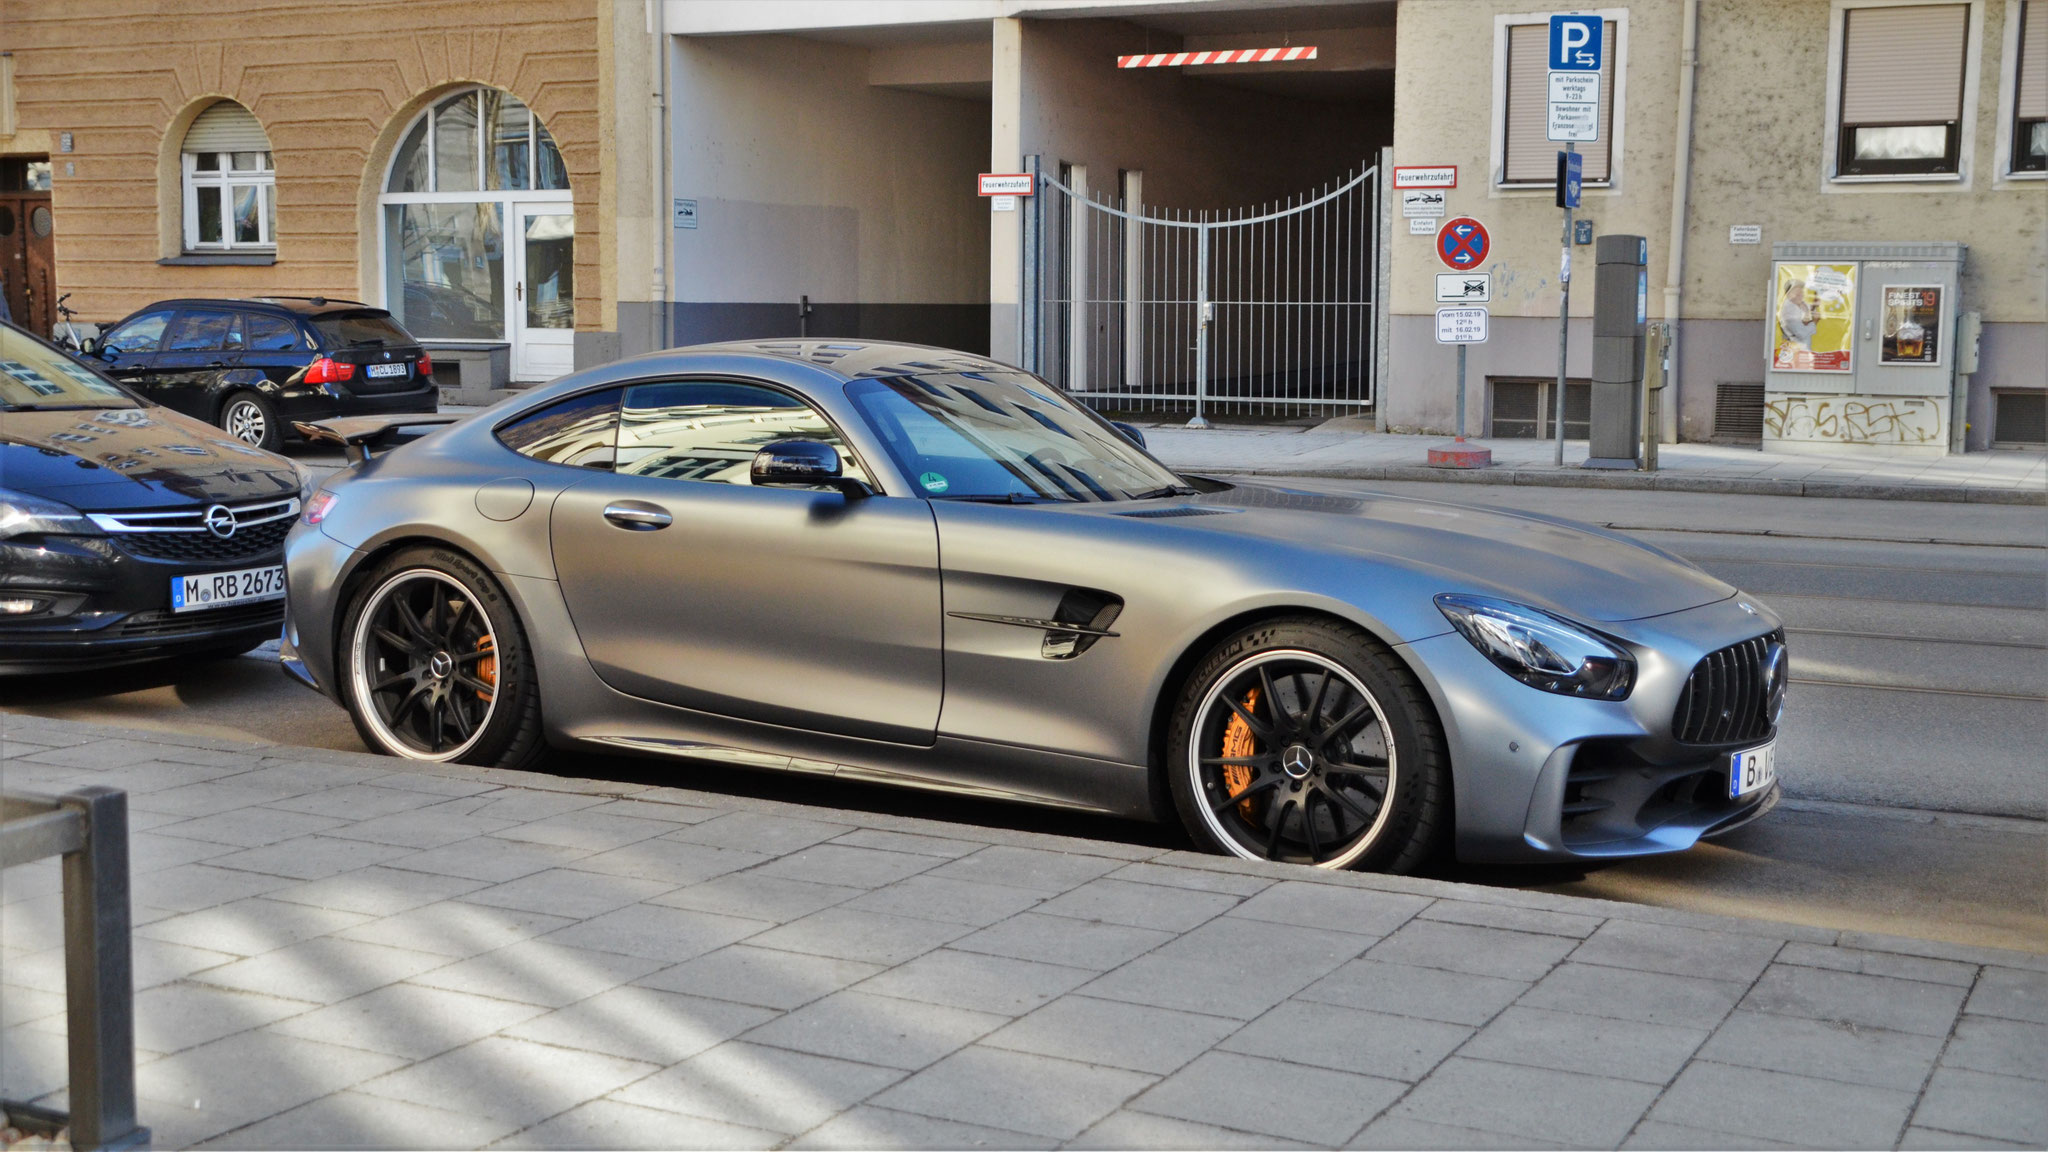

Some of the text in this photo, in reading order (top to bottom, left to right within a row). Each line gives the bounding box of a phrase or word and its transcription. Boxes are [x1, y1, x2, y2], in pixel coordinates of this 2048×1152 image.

[1561, 22, 1590, 63] P
[982, 180, 1030, 188] Feuerwehrzufahrt
[1398, 173, 1453, 181] Feuerwehrzufahrt
[185, 568, 284, 603] M RB 2673
[1746, 755, 1756, 787] B
